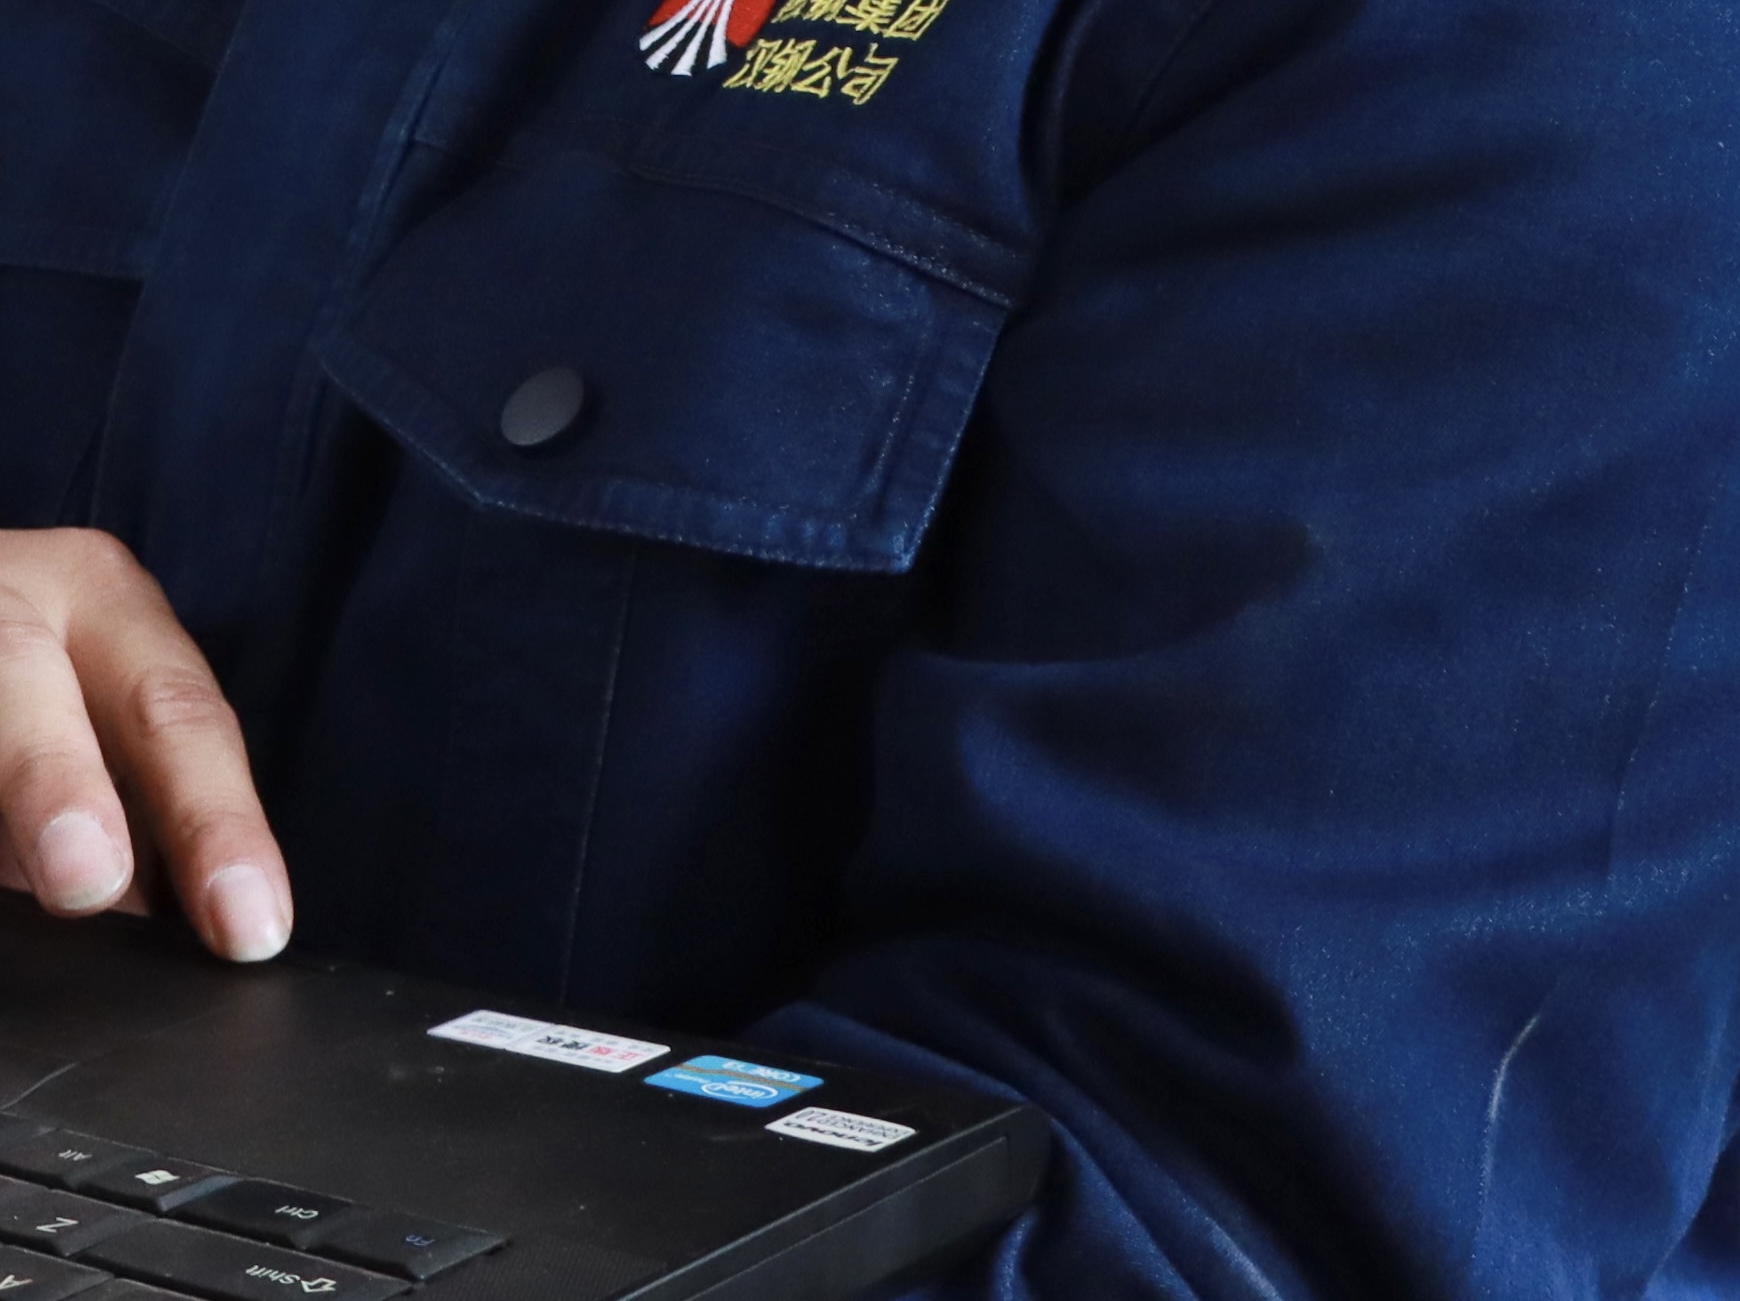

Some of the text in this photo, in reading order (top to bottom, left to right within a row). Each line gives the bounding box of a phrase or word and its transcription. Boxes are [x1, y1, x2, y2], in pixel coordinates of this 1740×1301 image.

[783, 1121, 883, 1147] lenovo
[275, 1205, 319, 1220] Ctrl
[36, 1216, 79, 1233] Z
[405, 1235, 435, 1246] Fn
[245, 1264, 302, 1286] Shift
